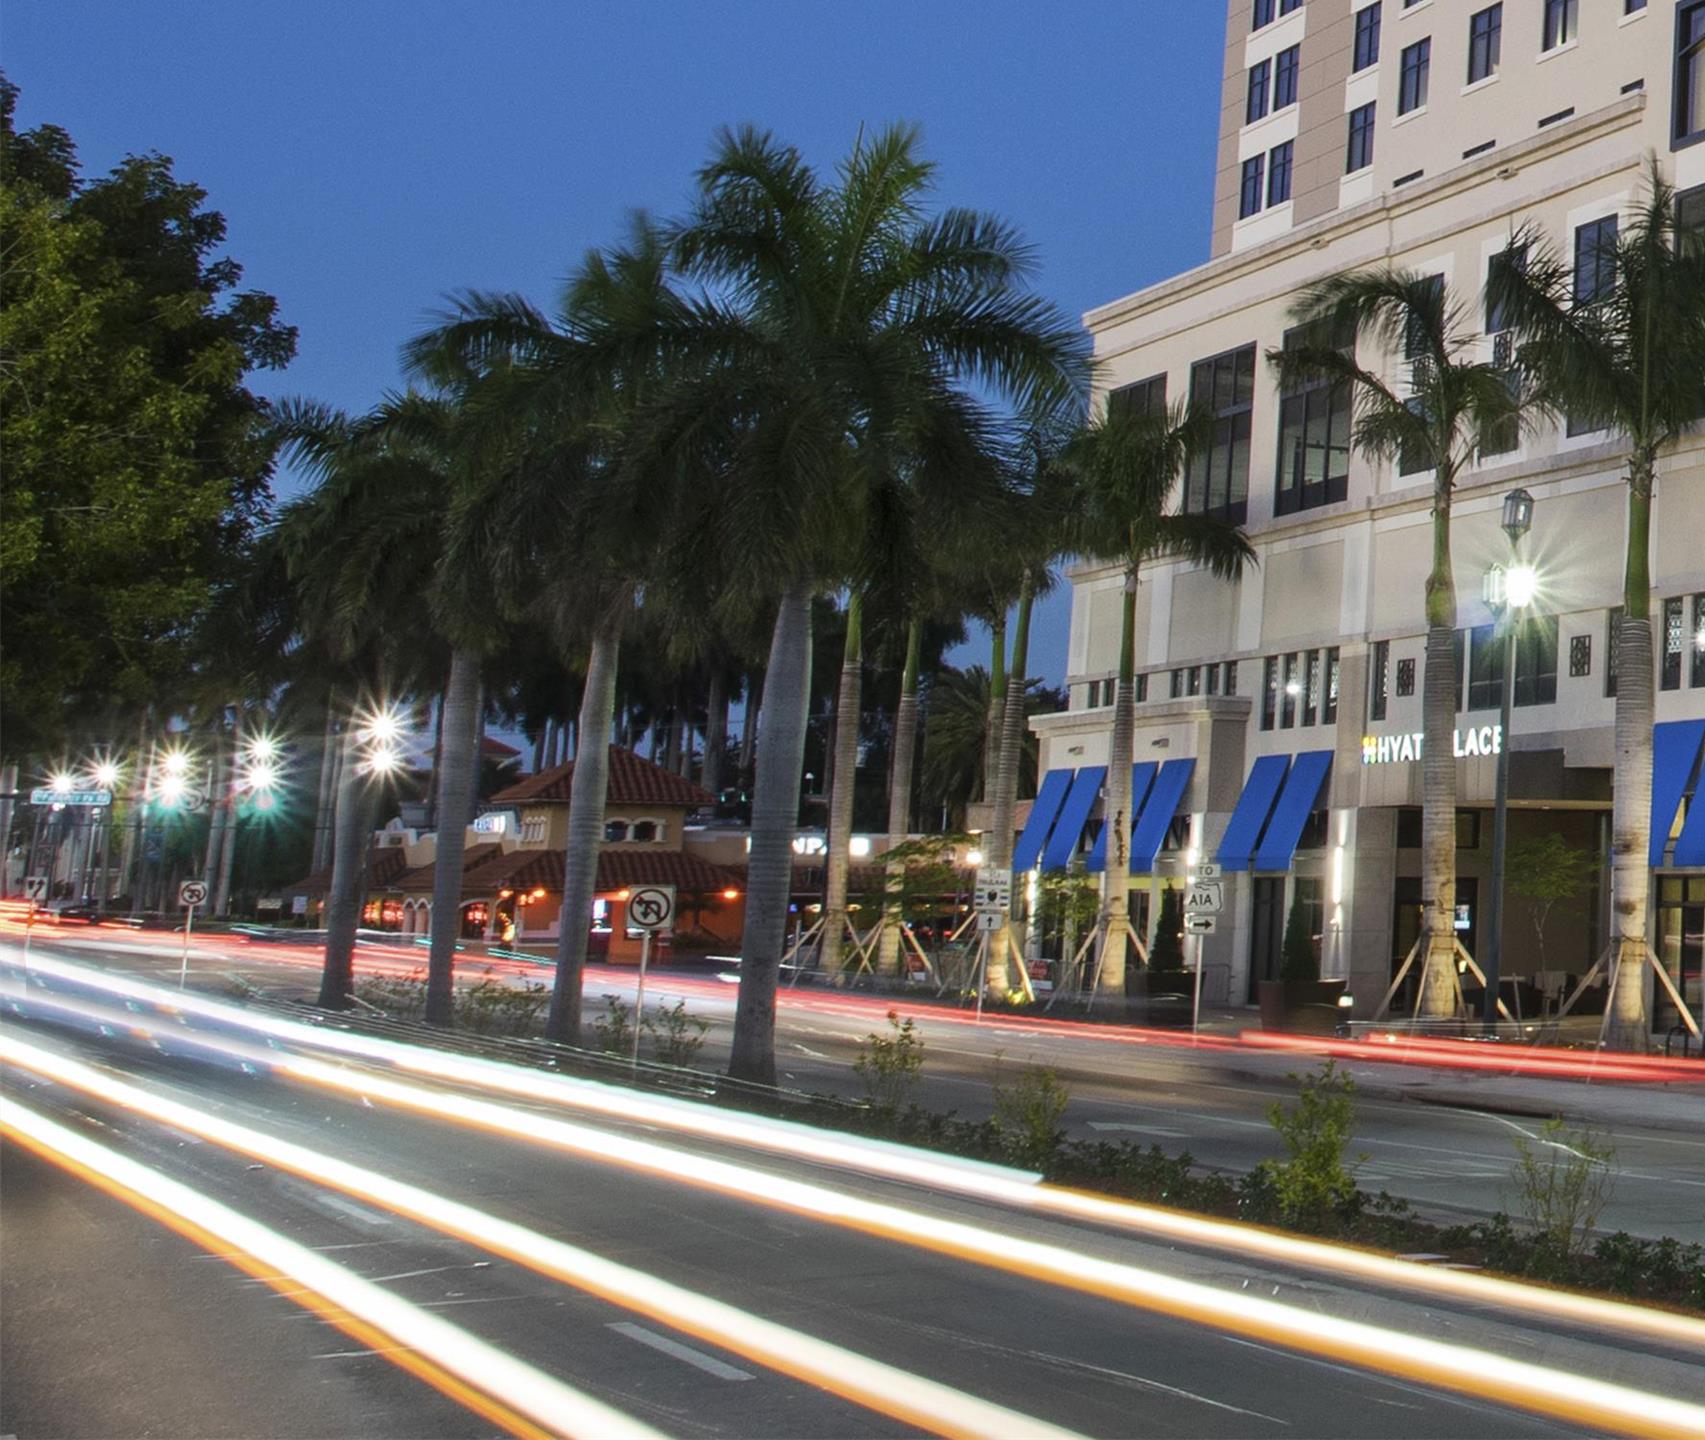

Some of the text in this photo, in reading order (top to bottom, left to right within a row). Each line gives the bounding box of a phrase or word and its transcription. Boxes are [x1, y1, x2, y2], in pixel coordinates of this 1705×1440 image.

[1377, 725, 1502, 763] HYAT LACE
[1198, 866, 1213, 876] TO
[1188, 893, 1213, 906] A1A
